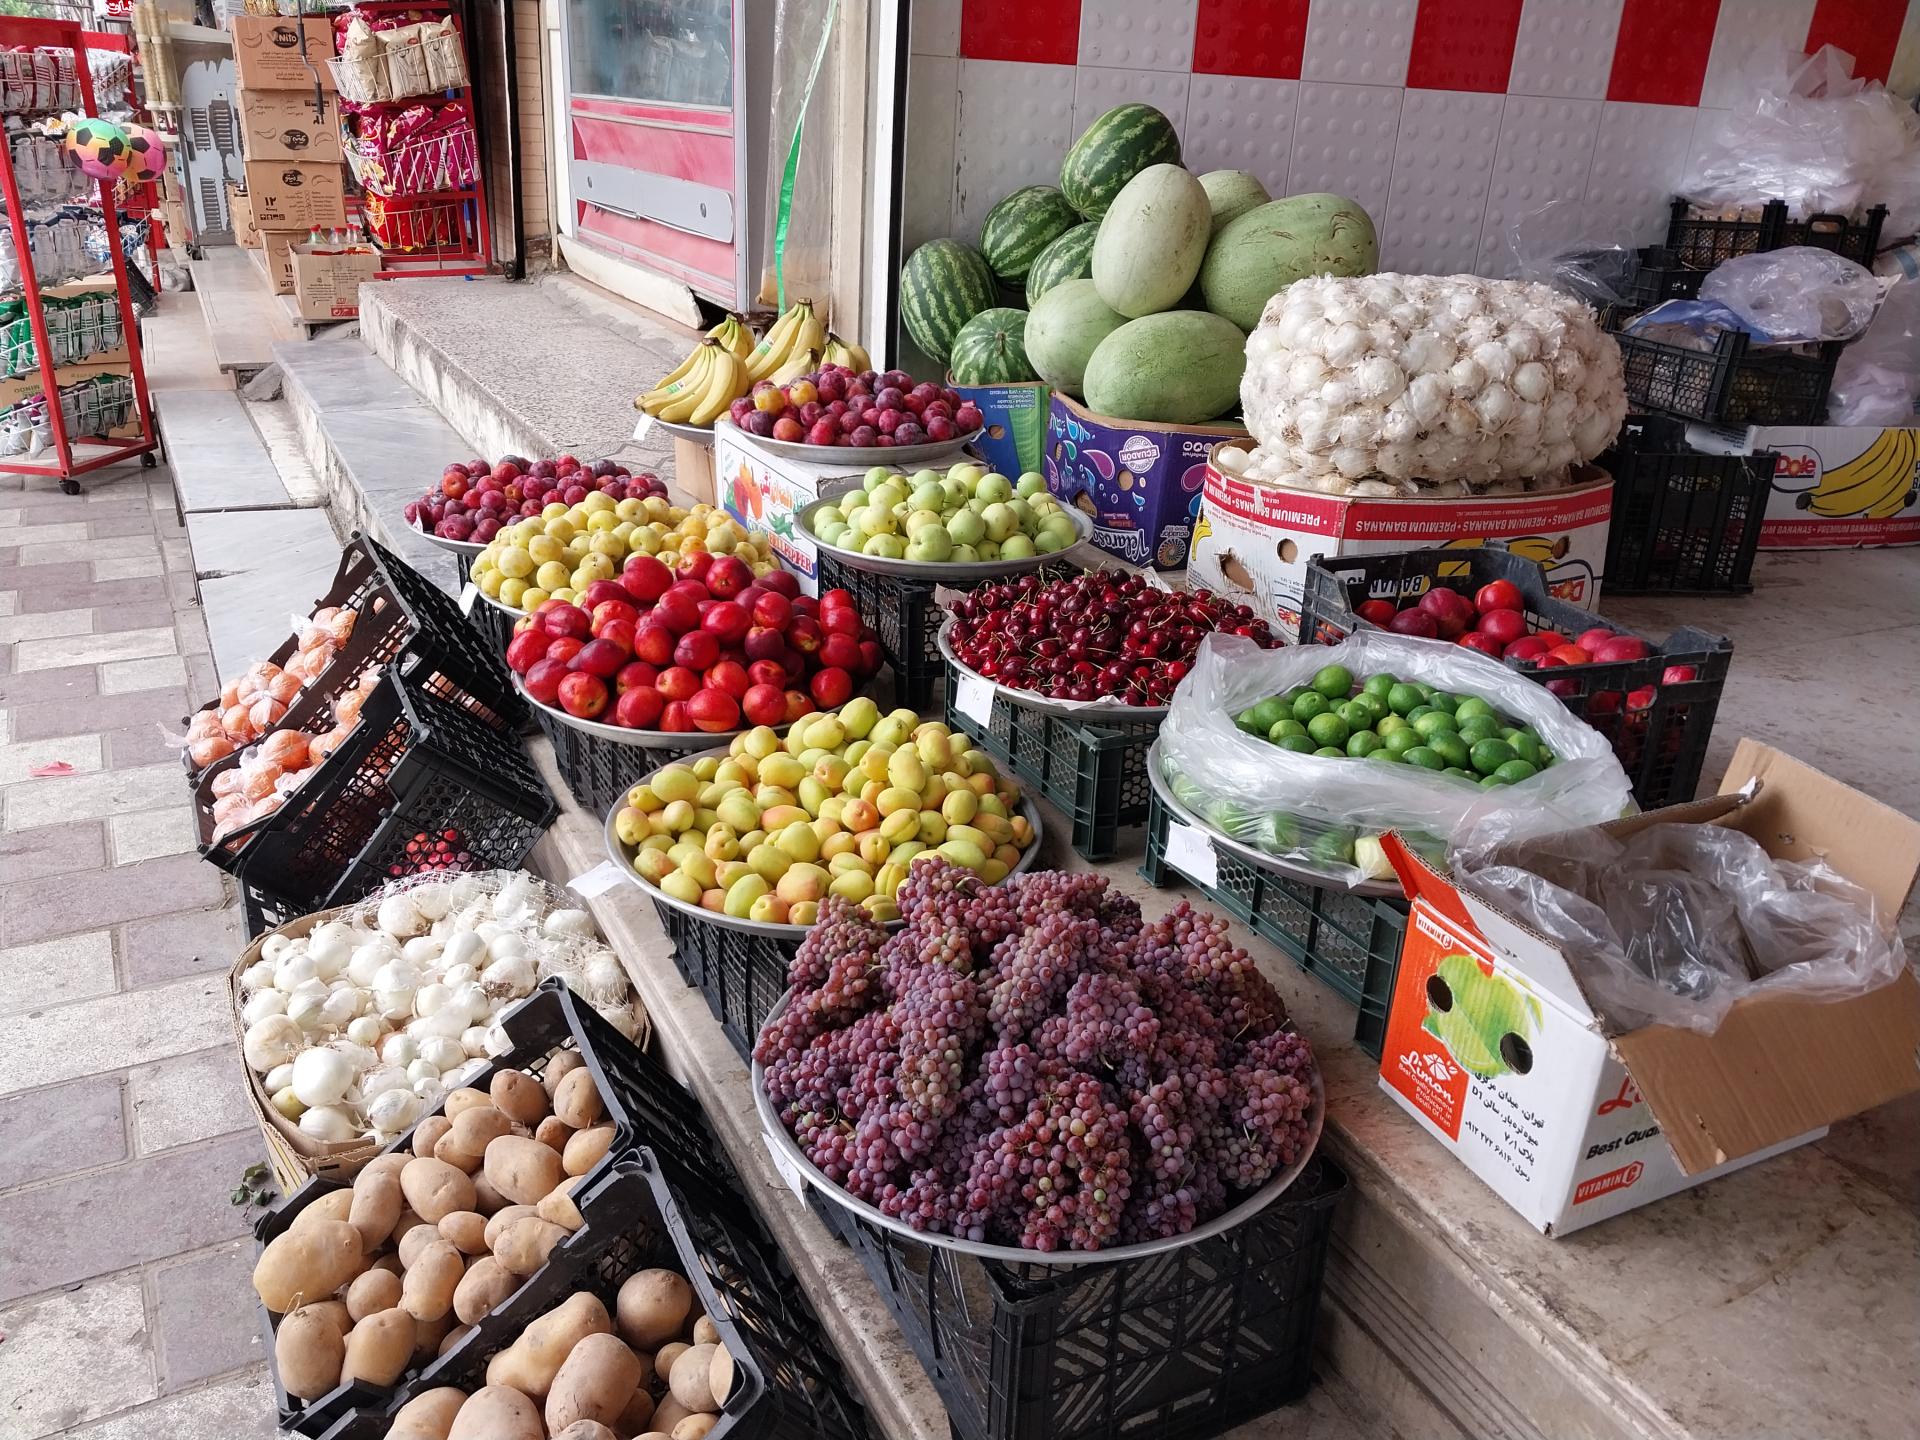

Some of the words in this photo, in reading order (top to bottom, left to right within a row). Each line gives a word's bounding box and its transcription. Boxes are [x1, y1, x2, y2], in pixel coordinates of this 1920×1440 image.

[1121, 448, 1158, 461] ECUADOR
[1774, 455, 1817, 477] Dole
[1272, 509, 1321, 527] PREMIUM
[1462, 519, 1506, 531] BANANAS
[1507, 517, 1546, 530] PREMIUM
[1552, 510, 1584, 525] BANANAS
[1355, 520, 1407, 532] BANANAS
[1408, 520, 1457, 532] PREMIUM
[1777, 525, 1812, 535] BANANAS
[1816, 524, 1850, 534] PREMIUM
[1849, 524, 1882, 533] BANANAS
[1417, 917, 1442, 941] VITAMIN
[1399, 1050, 1455, 1105] Limon
[1471, 1084, 1483, 1100] D1
[1498, 1090, 1519, 1109] میدان
[1586, 1137, 1623, 1160] Best
[1577, 1172, 1622, 1198] VITAMIN
[1625, 1164, 1638, 1183] C
